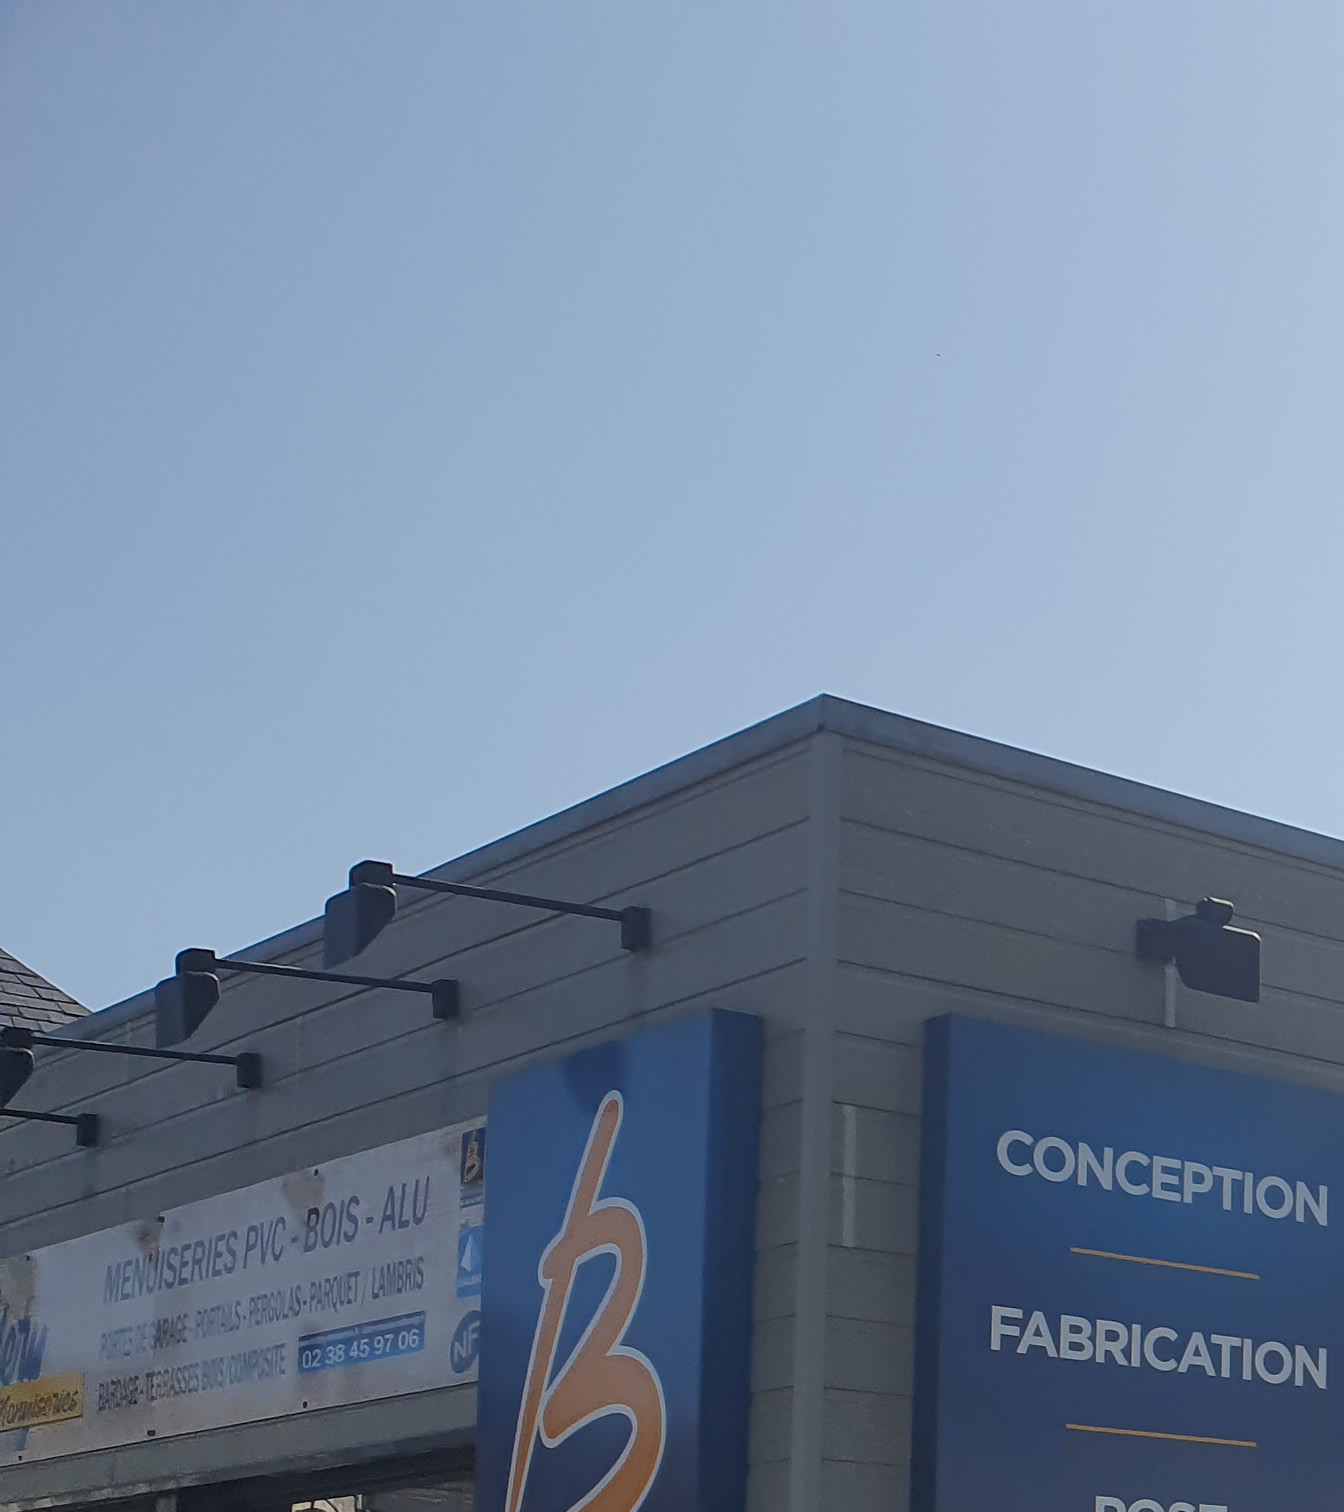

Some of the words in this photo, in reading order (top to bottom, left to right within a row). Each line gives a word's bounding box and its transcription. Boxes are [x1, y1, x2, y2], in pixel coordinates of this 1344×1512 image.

[997, 1129, 1329, 1227] CONCEPTION
[103, 1229, 238, 1303] MENUISERIES
[242, 1215, 286, 1269] PVC
[303, 1195, 360, 1252] BOIS
[378, 1176, 430, 1234] ALU
[309, 1271, 361, 1313] PARQUET
[371, 1255, 424, 1299] LAMBRIS
[302, 1349, 321, 1368] 02
[325, 1344, 344, 1365] 38
[349, 1338, 369, 1359] 45
[373, 1334, 393, 1355] 97
[398, 1329, 420, 1349] 06
[990, 1305, 1328, 1389] FABRICATION
